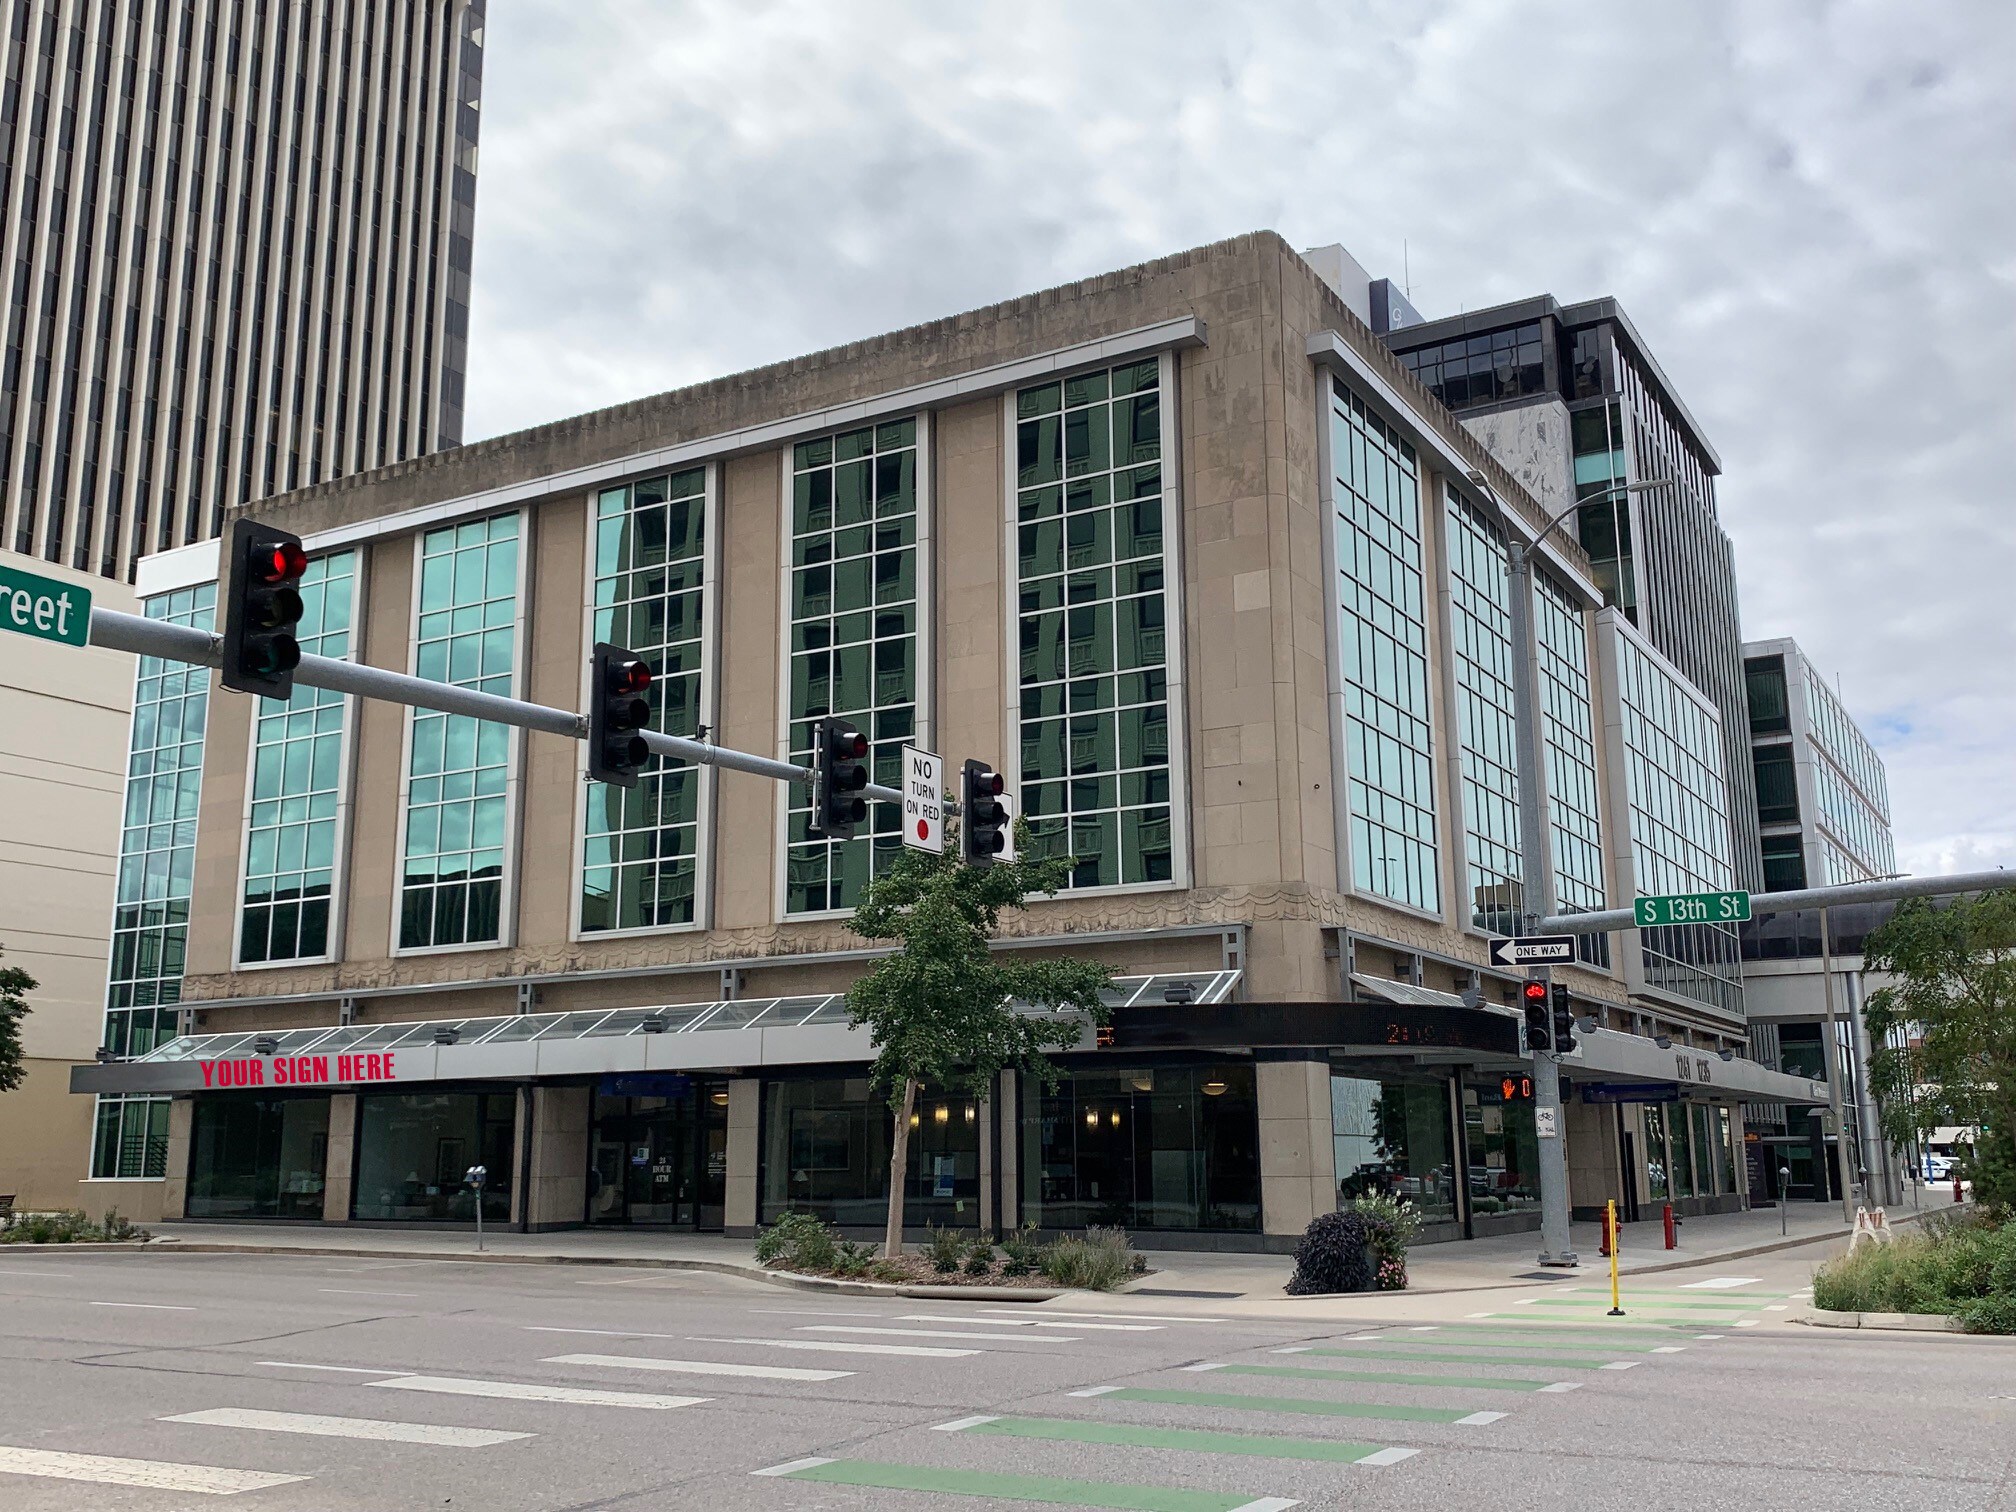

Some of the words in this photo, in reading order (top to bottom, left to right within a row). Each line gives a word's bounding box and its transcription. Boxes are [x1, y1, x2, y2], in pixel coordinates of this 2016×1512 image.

[913, 757, 932, 779] NO
[911, 781, 935, 800] TURN
[906, 800, 918, 815] ON
[923, 804, 939, 821] RED
[1644, 900, 1657, 922] S
[1667, 898, 1708, 921] 13th
[1719, 895, 1741, 918] St
[1516, 946, 1538, 957] ONE
[1541, 945, 1563, 956] WAY
[200, 1059, 264, 1088] YOUR
[273, 1056, 329, 1085] SIGN
[337, 1053, 396, 1082] HERE
[652, 1165, 672, 1174] HOUR
[654, 1174, 669, 1183] ATM
